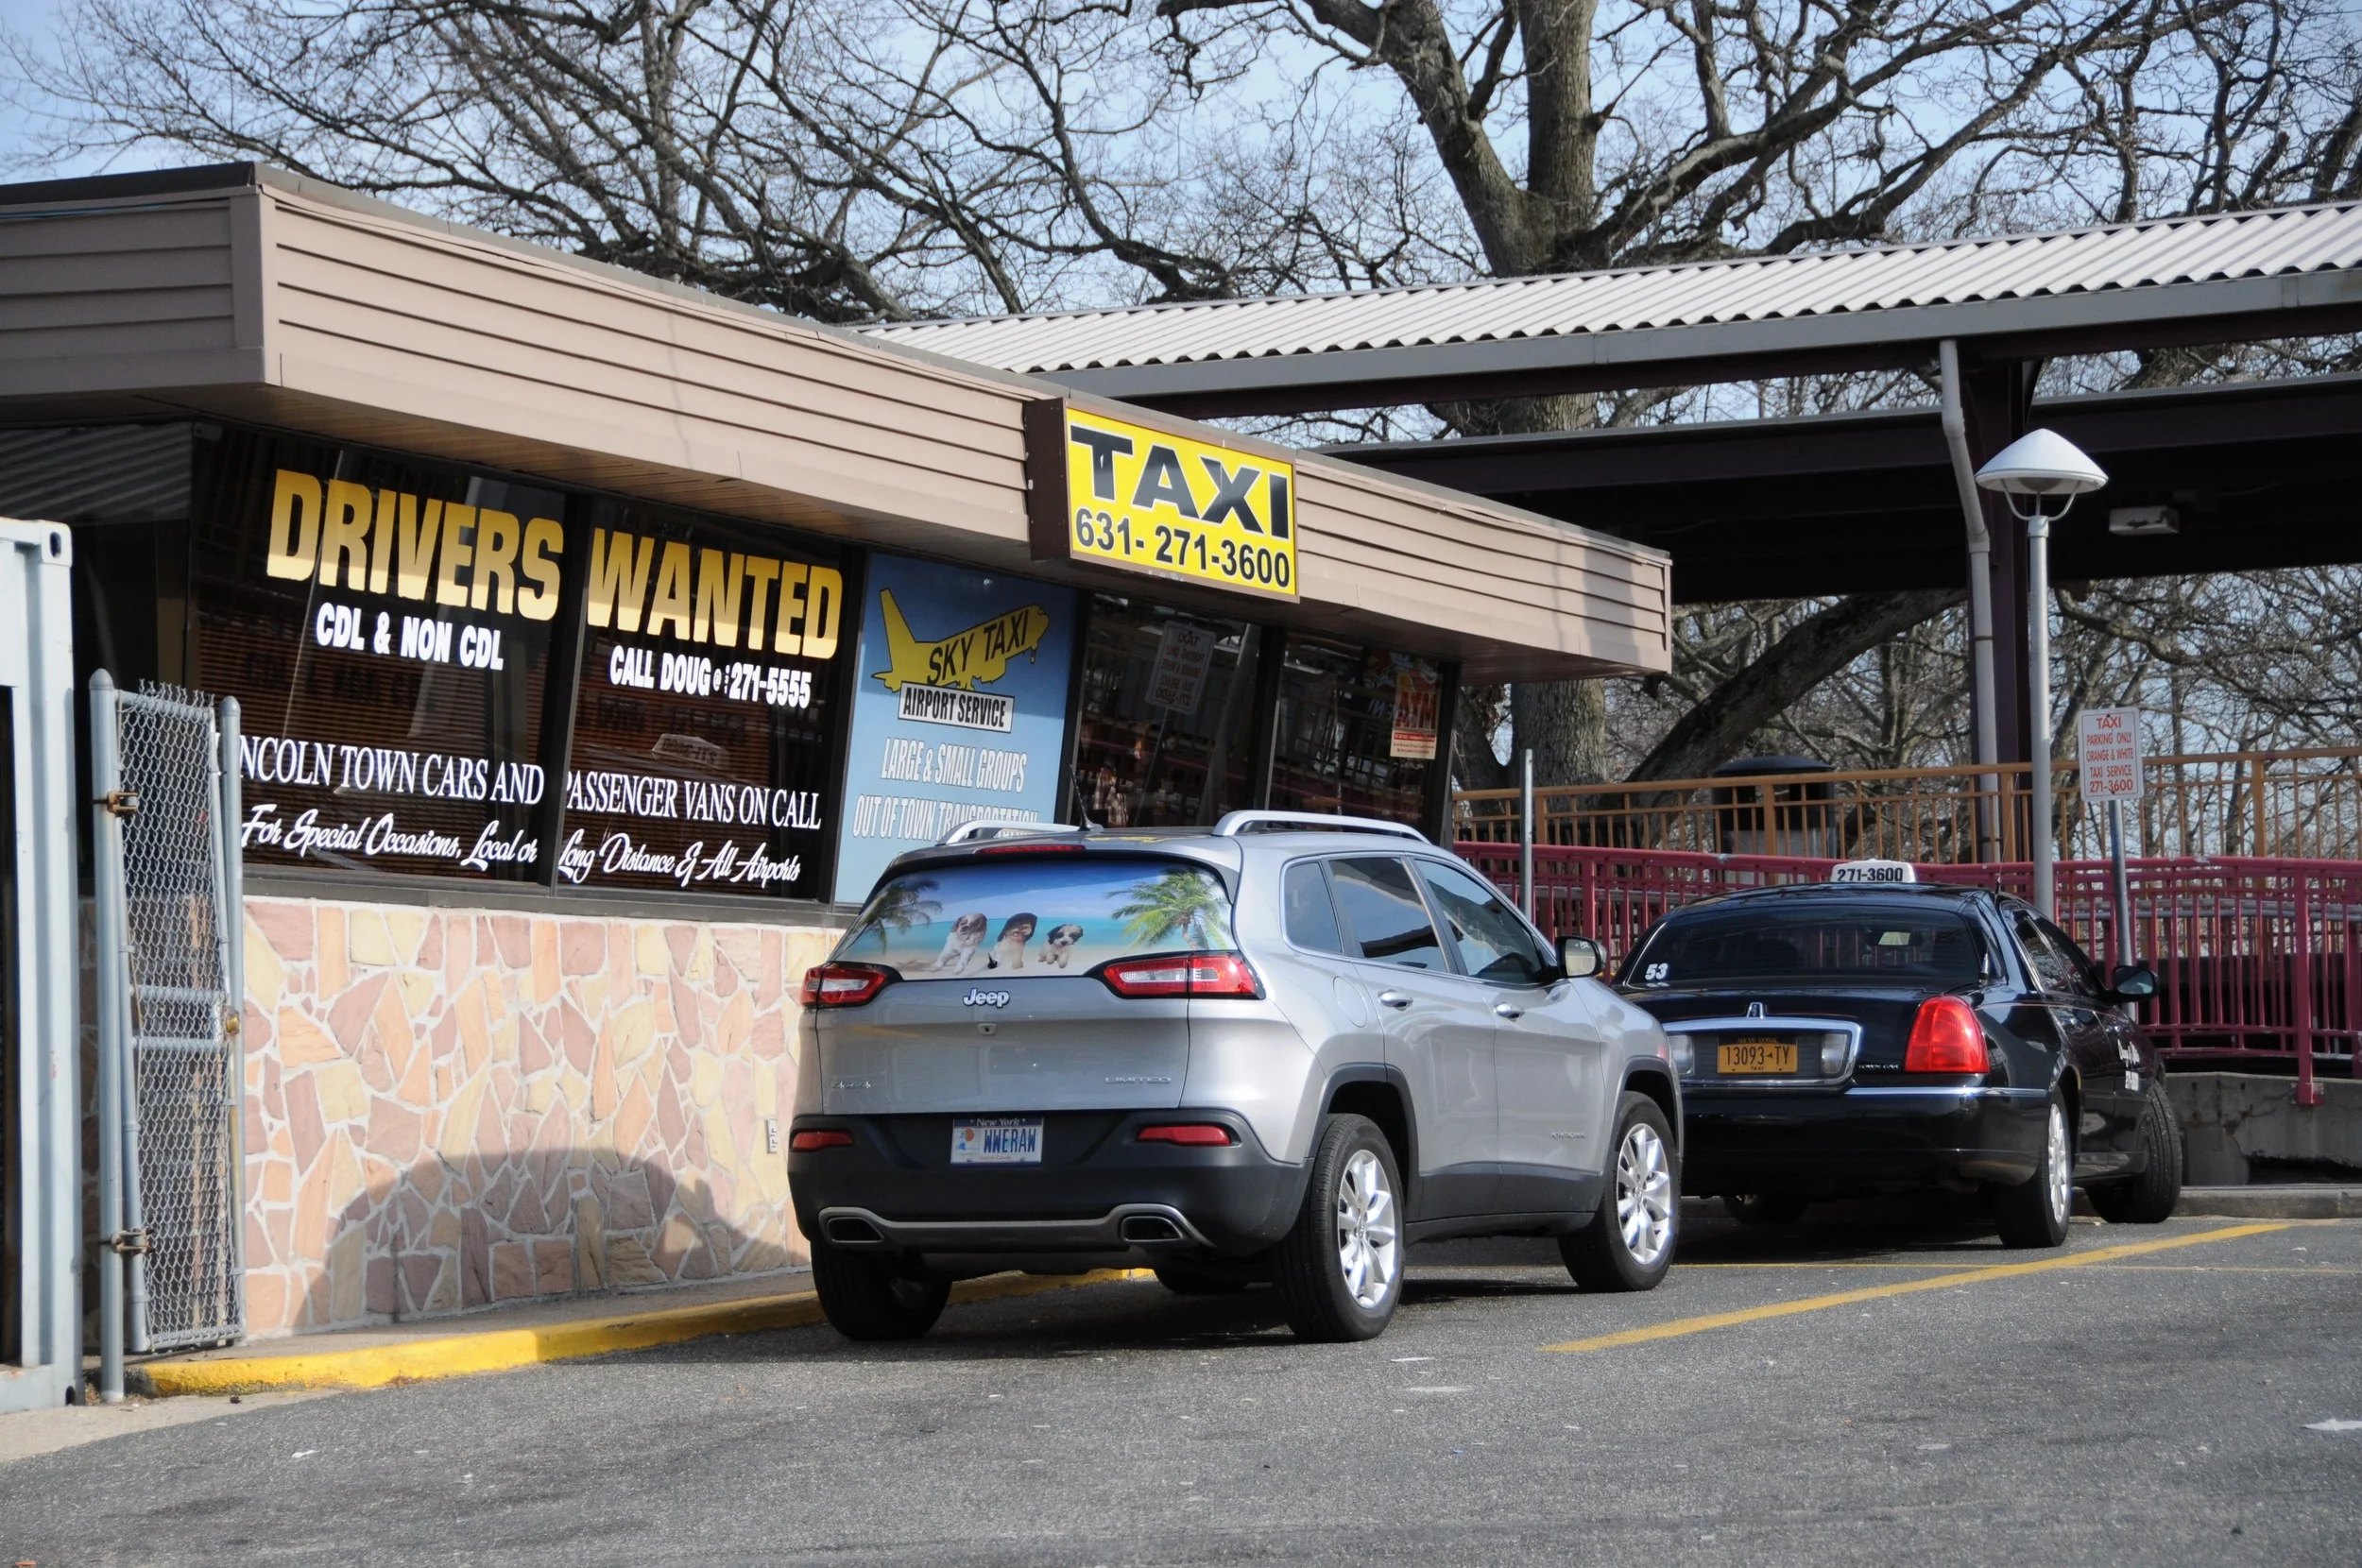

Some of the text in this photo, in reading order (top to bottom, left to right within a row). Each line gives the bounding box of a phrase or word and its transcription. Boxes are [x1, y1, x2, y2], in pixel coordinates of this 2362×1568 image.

[1070, 422, 1290, 540] TAXI
[266, 469, 843, 659] DRIVERS WANTED
[1075, 507, 1291, 588] 631- 271-3600
[317, 603, 504, 671] CDL & NON CDL
[927, 609, 1030, 685] SKY TAXI
[609, 645, 655, 689] CALL
[660, 653, 711, 696] DOUG
[728, 661, 812, 708] 271-5555
[903, 687, 1006, 728] AIRPORT SERVICE
[2096, 716, 2122, 729] TAXI
[2086, 732, 2132, 746] PARKING ONLY
[2086, 749, 2109, 762] ORANGE
[2116, 747, 2134, 759] WHITE
[239, 735, 545, 805] NCOLN TOWN CARS AND
[881, 738, 1027, 793] LARGE & SMALL GROUPS
[2090, 765, 2132, 778] TAXI SERVICE
[2090, 779, 2133, 793] 271-3600
[684, 780, 736, 823] VANS
[739, 786, 770, 826] ON
[771, 789, 821, 830] CALL
[853, 794, 882, 838] OUT
[880, 795, 898, 839] OF
[898, 797, 936, 841] TOWN
[241, 804, 538, 872] For Special Occasions, Local or
[558, 828, 801, 889] Long Distance & All Airports
[1837, 867, 1904, 882] 271-3600
[1645, 963, 1669, 980] 53
[963, 987, 1010, 1009] Jeep
[976, 1117, 1020, 1126] New York
[984, 1128, 1036, 1153] WWERAW
